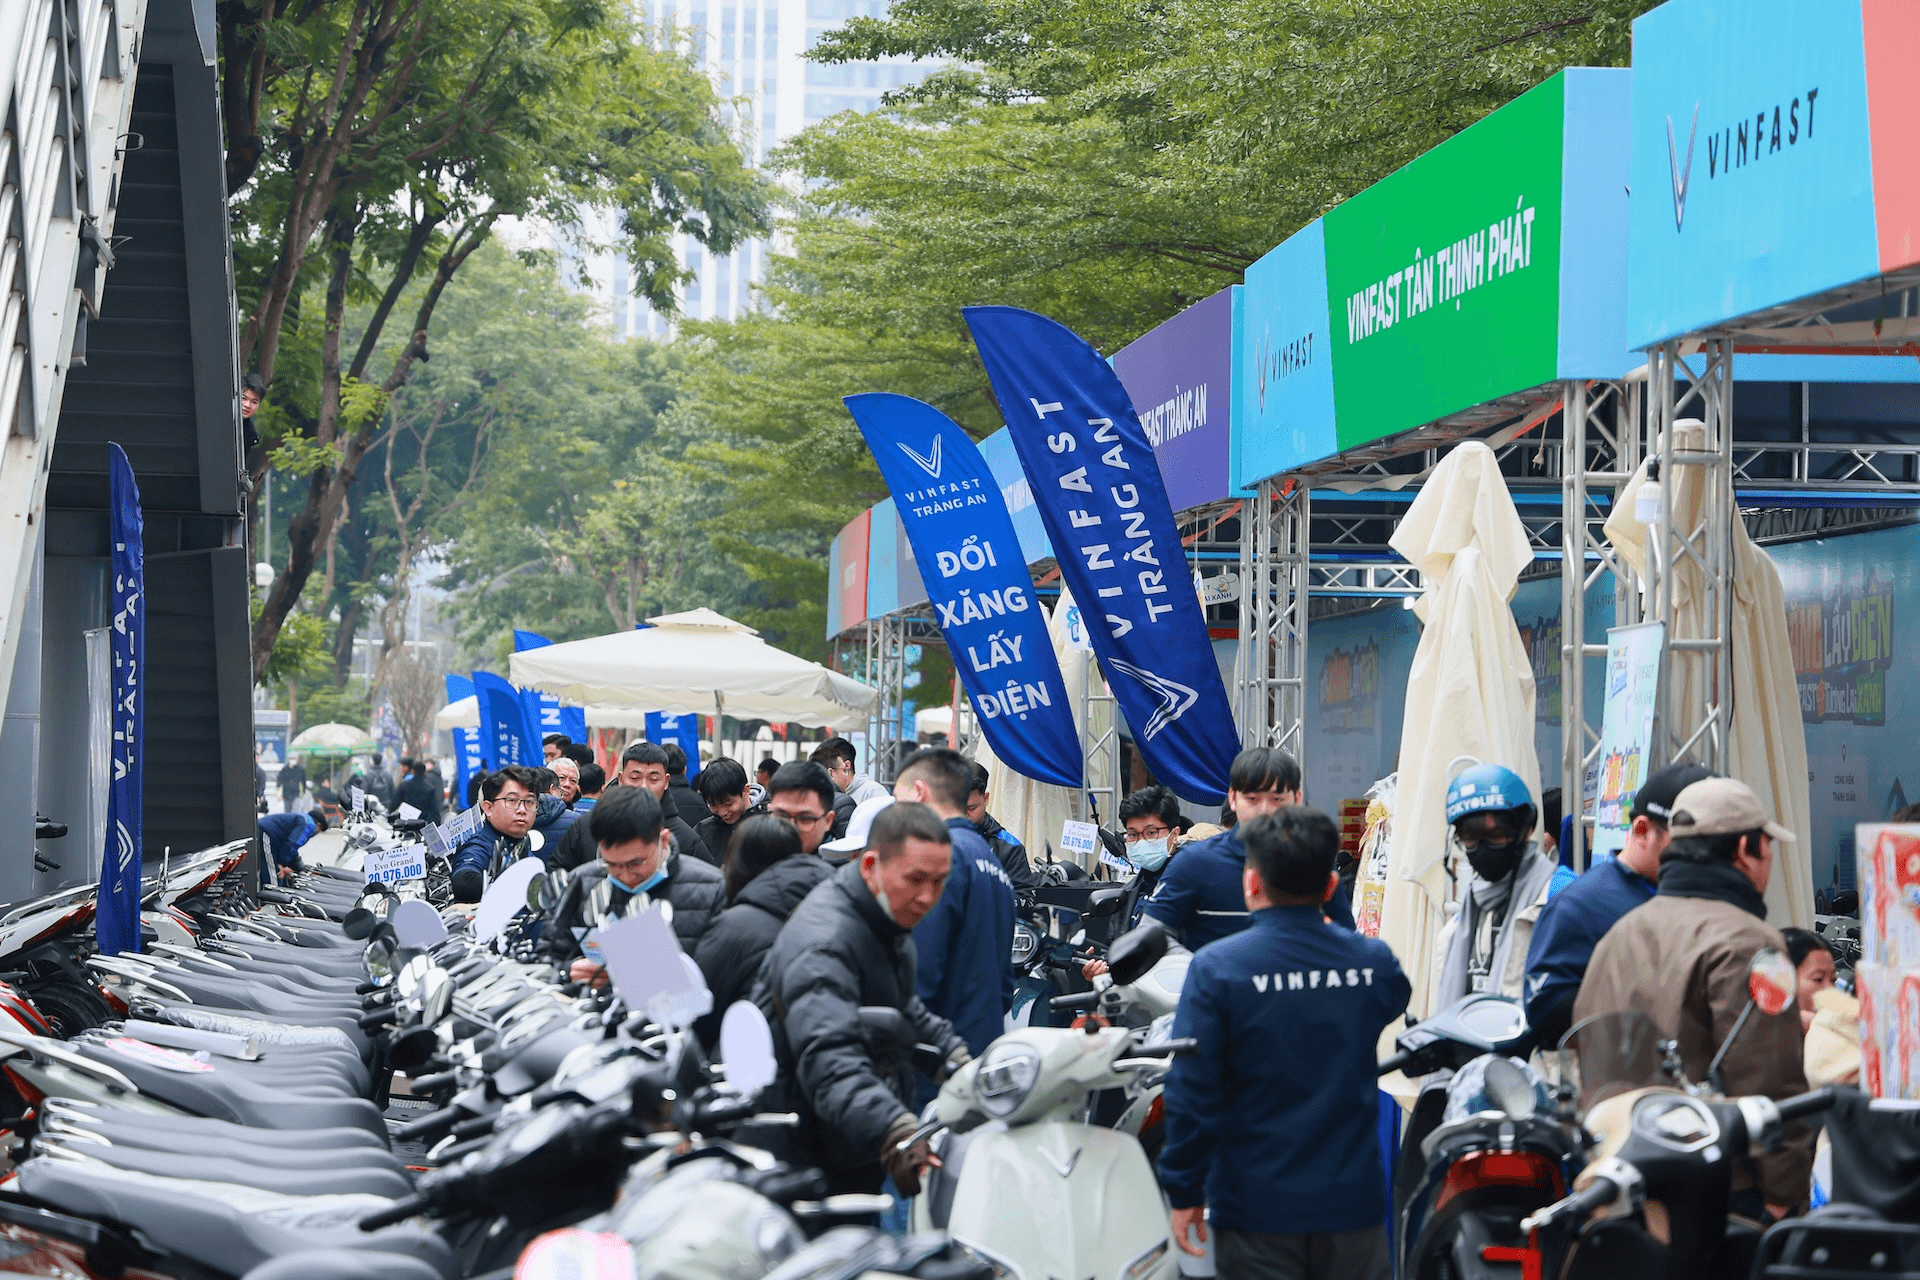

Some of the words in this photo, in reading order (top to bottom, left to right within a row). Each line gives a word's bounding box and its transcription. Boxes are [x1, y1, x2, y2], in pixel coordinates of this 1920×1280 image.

[1708, 86, 1819, 180] VINFAST
[1346, 270, 1403, 345] VINFAST
[1404, 247, 1434, 319] TÂN
[1436, 229, 1486, 312] THỊNH
[1487, 194, 1536, 282] PHÁT
[1271, 332, 1313, 383] VINFAST
[1165, 384, 1193, 442] TRÀNG
[1193, 382, 1207, 430] AN
[1087, 416, 1131, 470] AN
[904, 478, 981, 503] VINFAST
[912, 498, 964, 519] TRÀNG
[966, 493, 988, 507] AN
[1029, 397, 1134, 639] VINFAST
[935, 534, 998, 579] ĐỔI
[1111, 483, 1174, 623] TRÀNG
[935, 586, 1029, 630] XĂNG
[1211, 592, 1233, 602] XANH
[967, 629, 1023, 674] LẤY
[976, 679, 1052, 722] ĐIỆN
[374, 863, 390, 871] Evo
[390, 856, 414, 868] Grand
[1062, 835, 1093, 850] 20.976.000
[368, 863, 422, 885] 20.976.000
[1251, 967, 1374, 994] VINFAST
